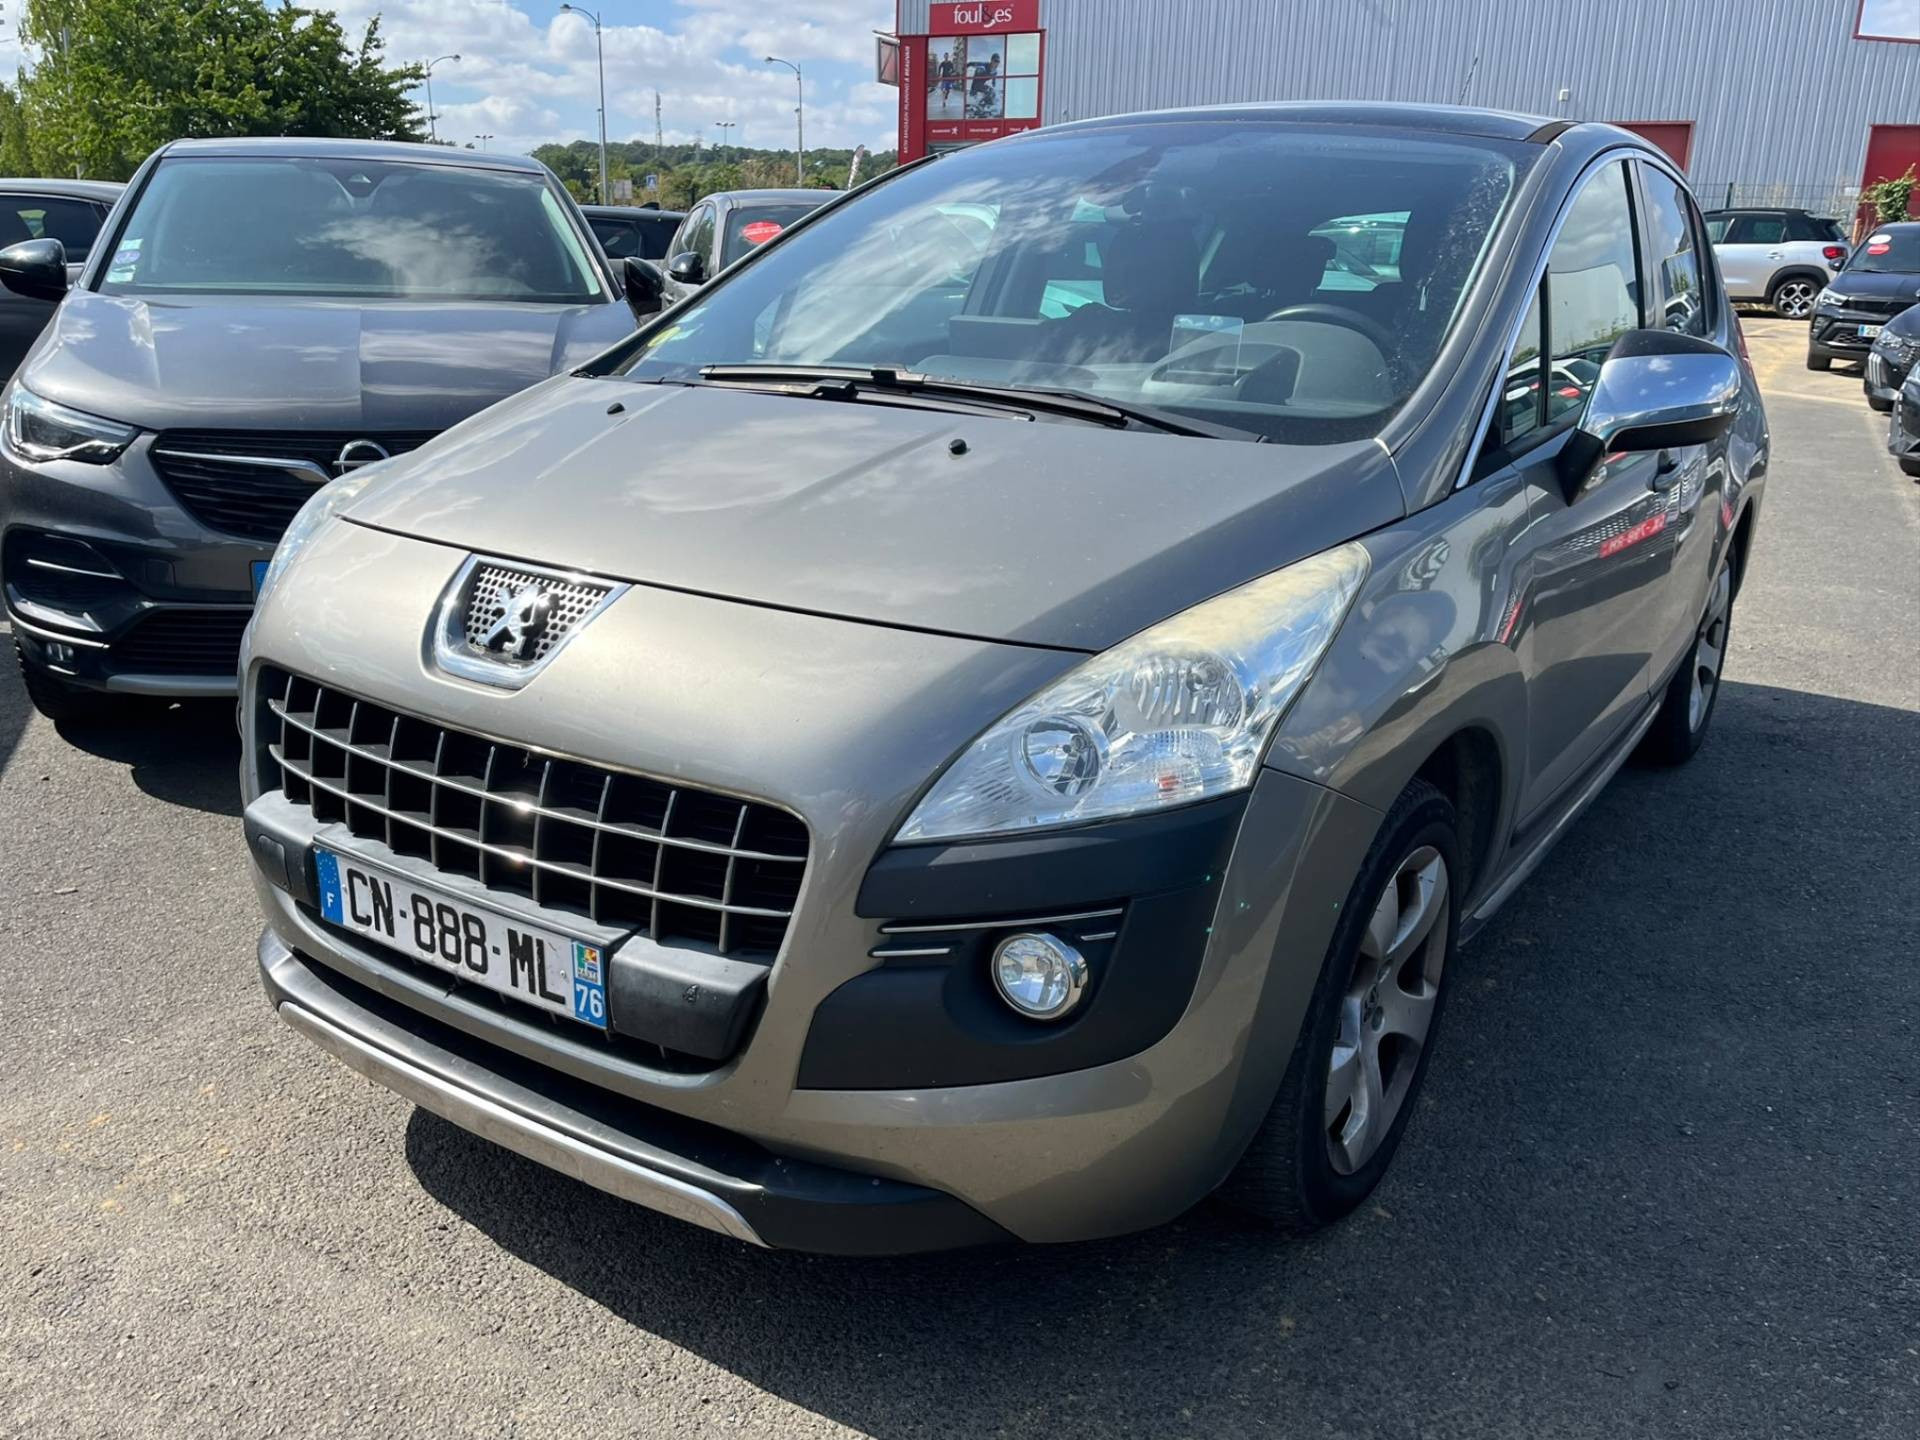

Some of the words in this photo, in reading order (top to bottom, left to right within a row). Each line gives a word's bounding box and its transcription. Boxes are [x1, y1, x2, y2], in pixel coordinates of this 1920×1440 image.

[327, 891, 335, 908] F
[346, 868, 566, 1005] CN-888-ML
[576, 983, 603, 1018] 76
